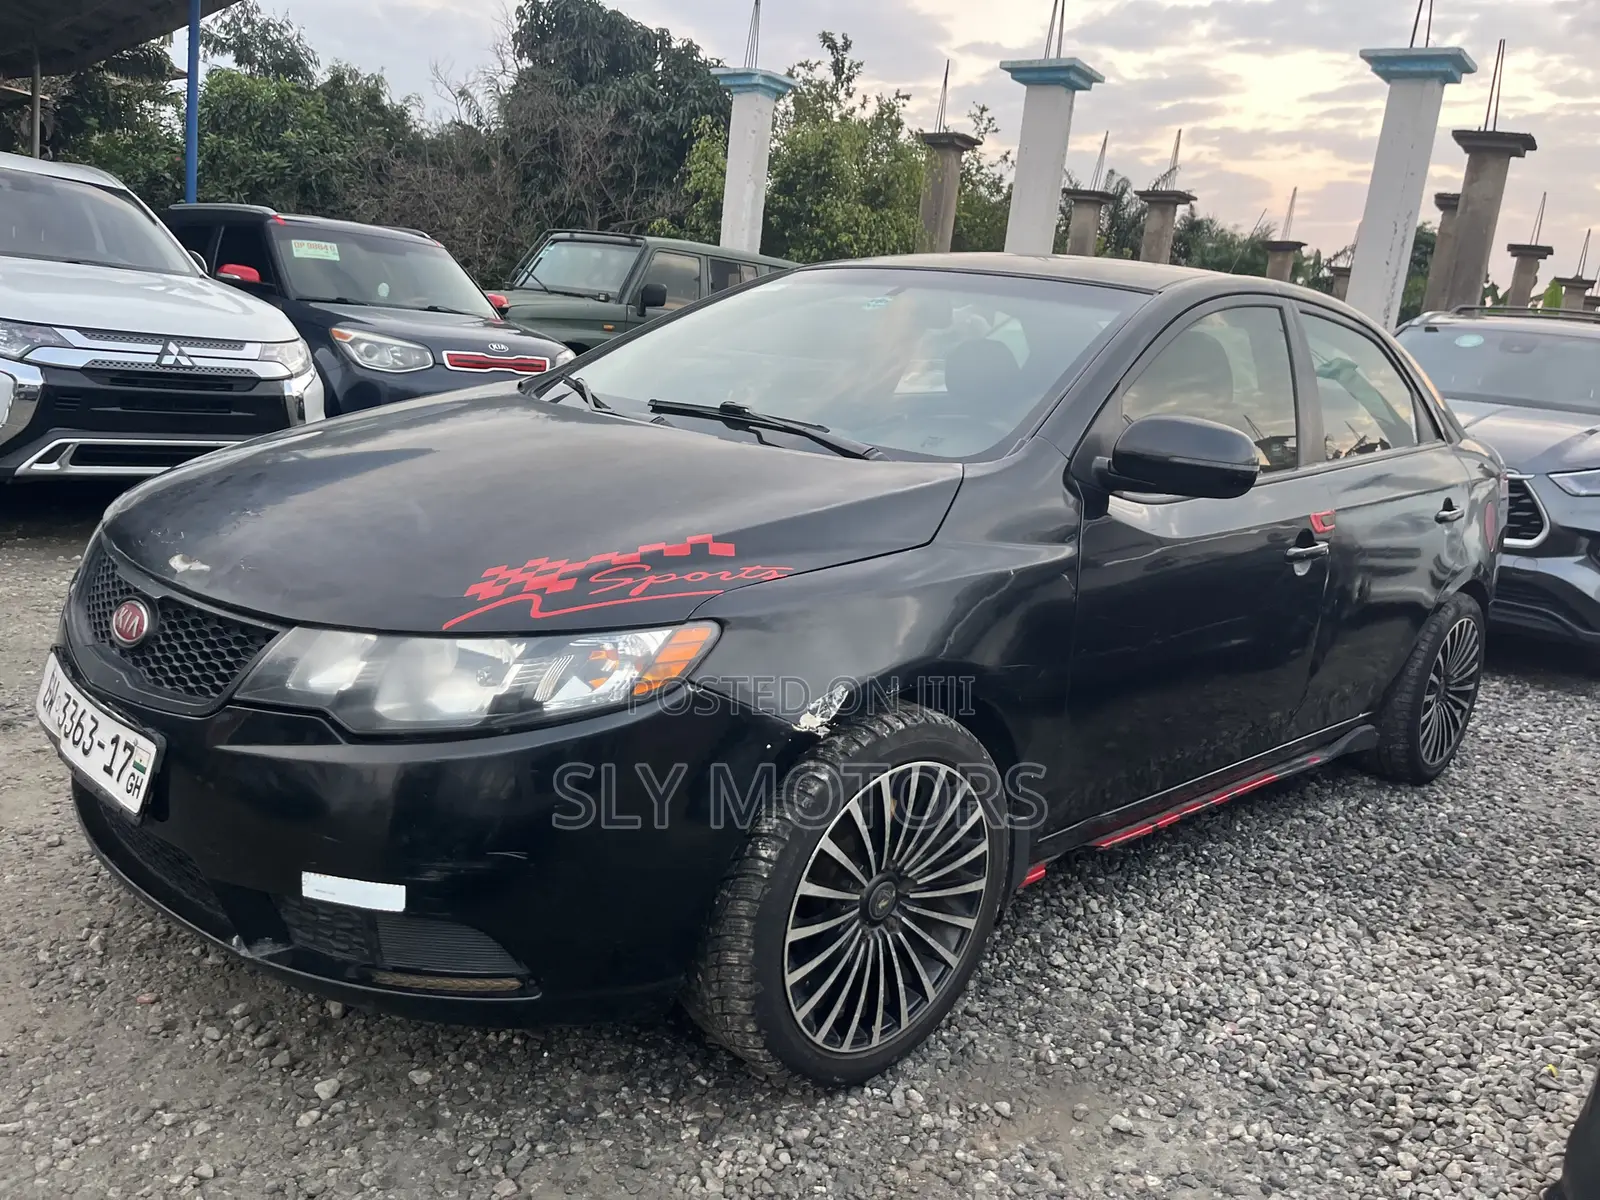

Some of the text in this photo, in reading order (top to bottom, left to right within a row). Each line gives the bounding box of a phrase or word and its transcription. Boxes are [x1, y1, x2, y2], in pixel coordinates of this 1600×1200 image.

[489, 343, 508, 352] KIA
[589, 564, 793, 595] Sports
[116, 606, 140, 638] KIA
[57, 692, 135, 782] 3363-17
[126, 772, 144, 799] GH
